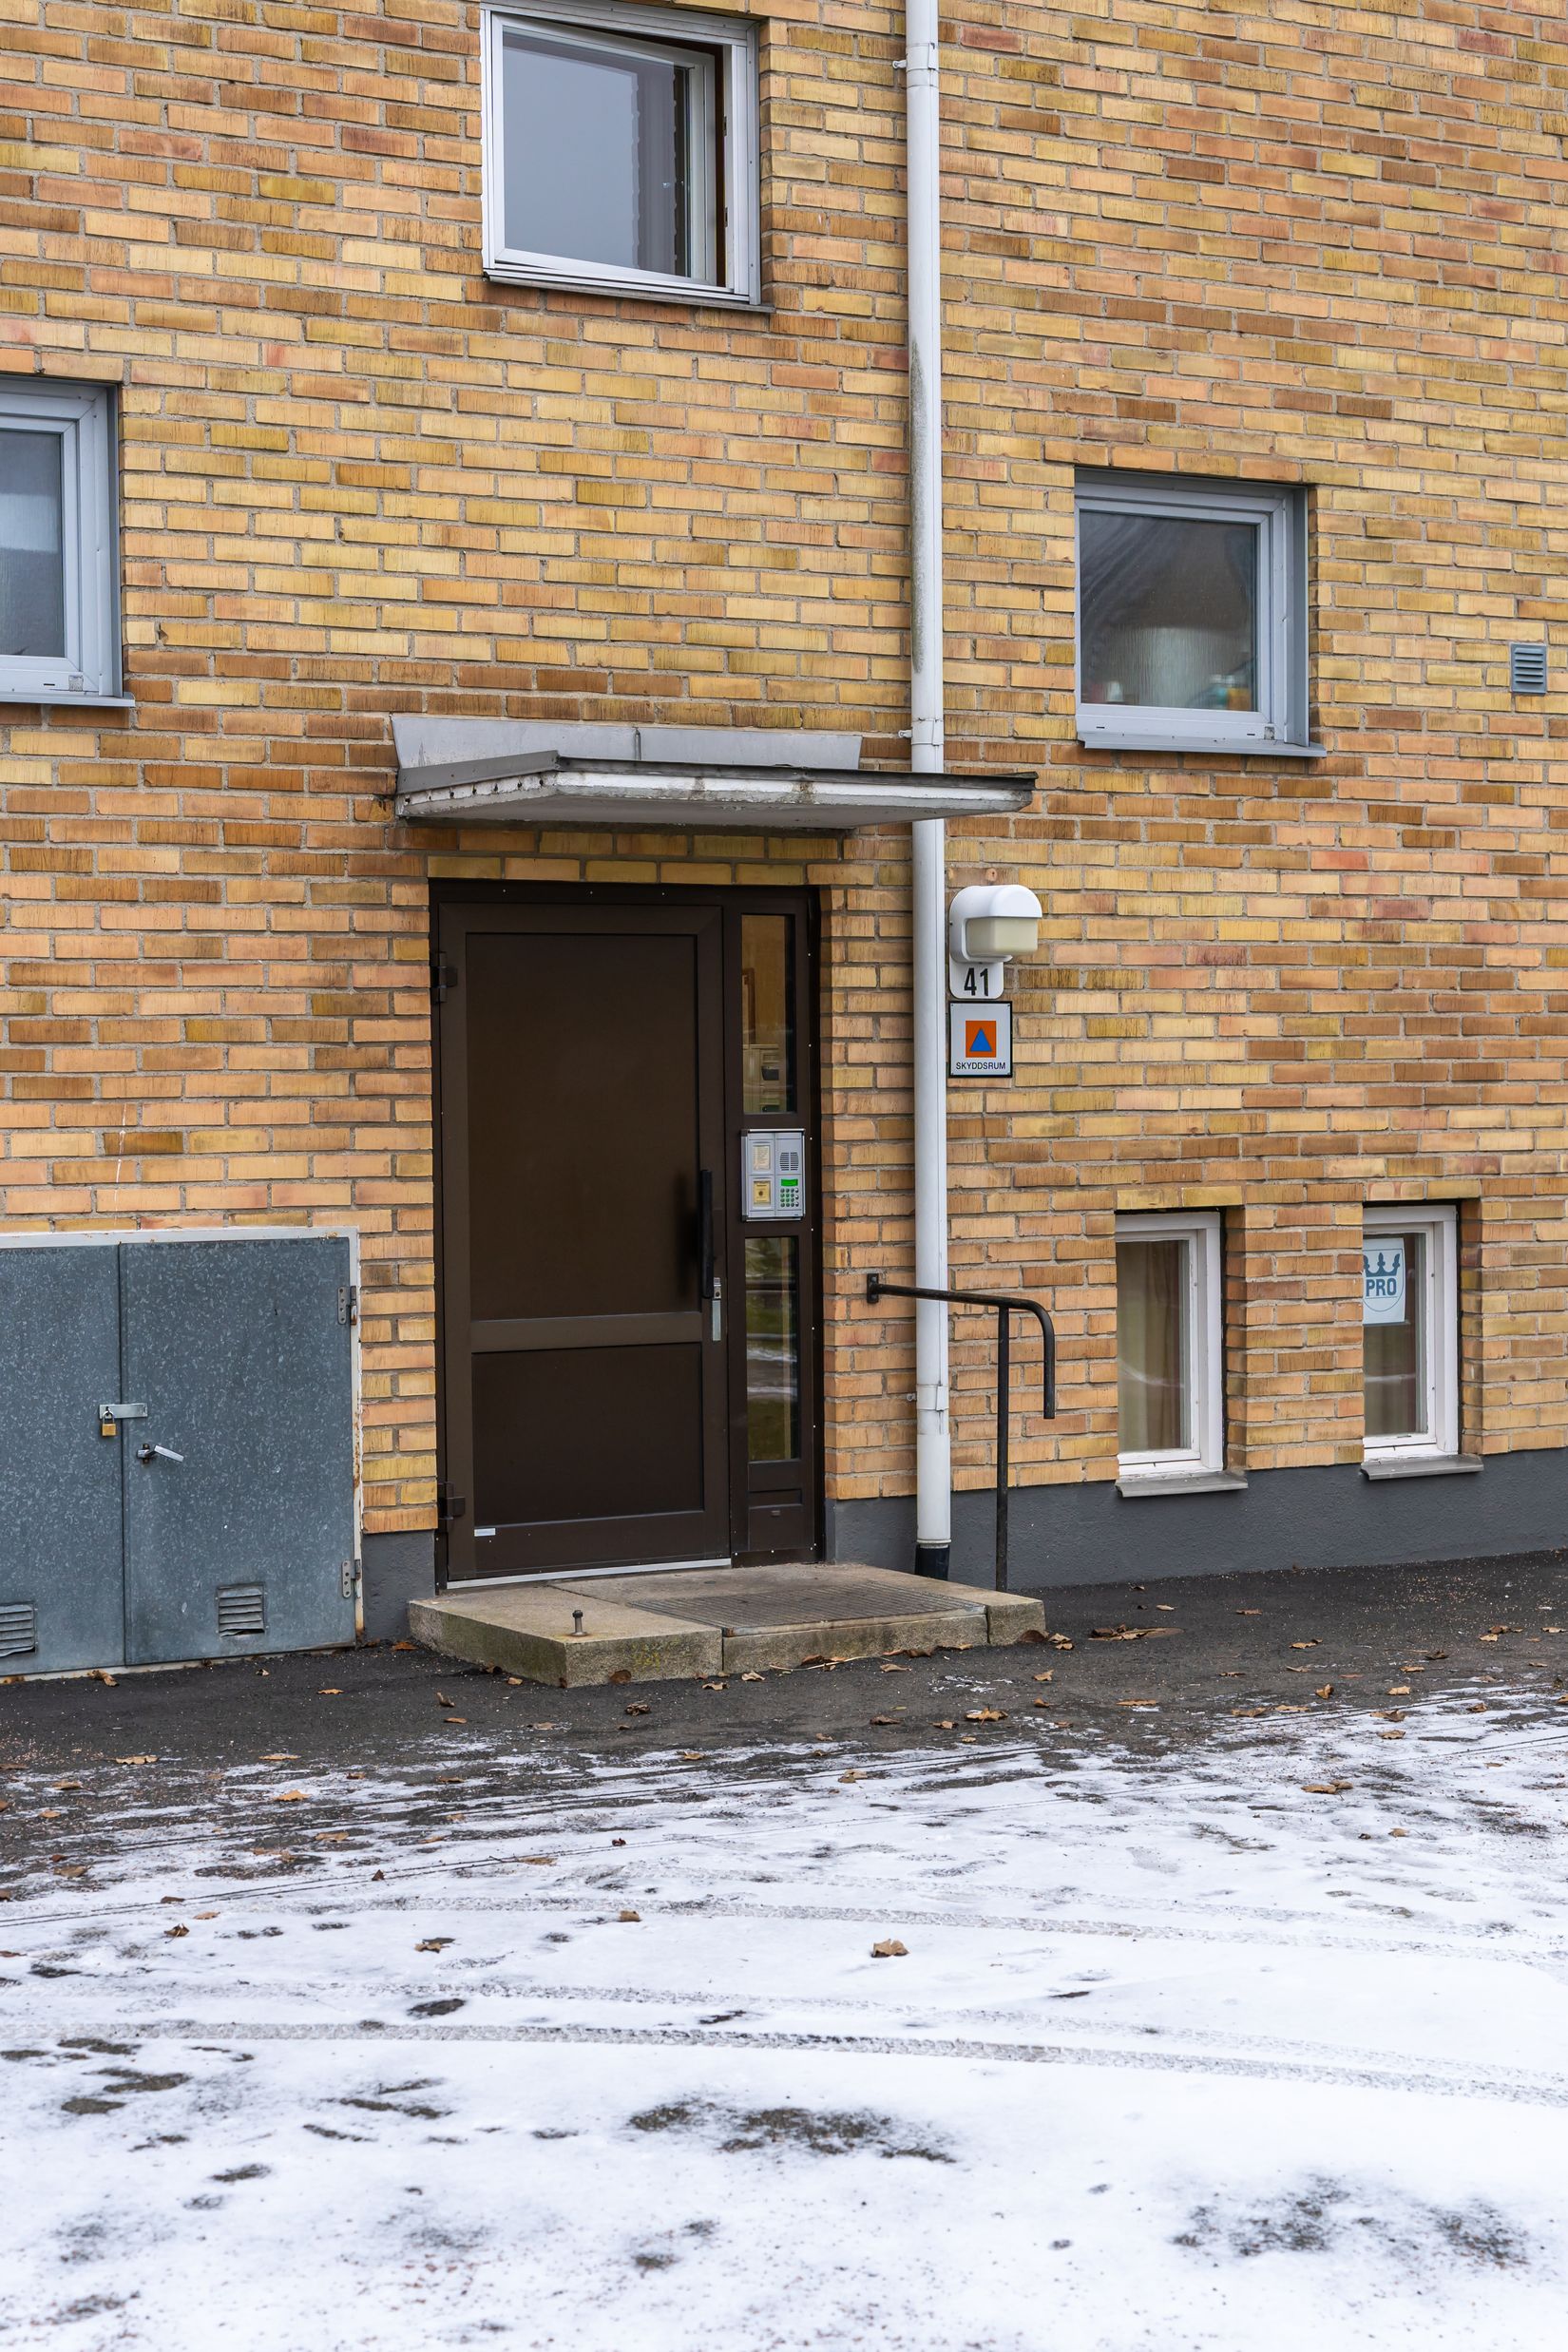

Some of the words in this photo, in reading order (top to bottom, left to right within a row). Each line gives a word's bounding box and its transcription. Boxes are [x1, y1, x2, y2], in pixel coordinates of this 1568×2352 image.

[964, 967, 989, 997] 41
[956, 1061, 1006, 1070] SKYDDSRUM
[1366, 1277, 1397, 1297] PRO
